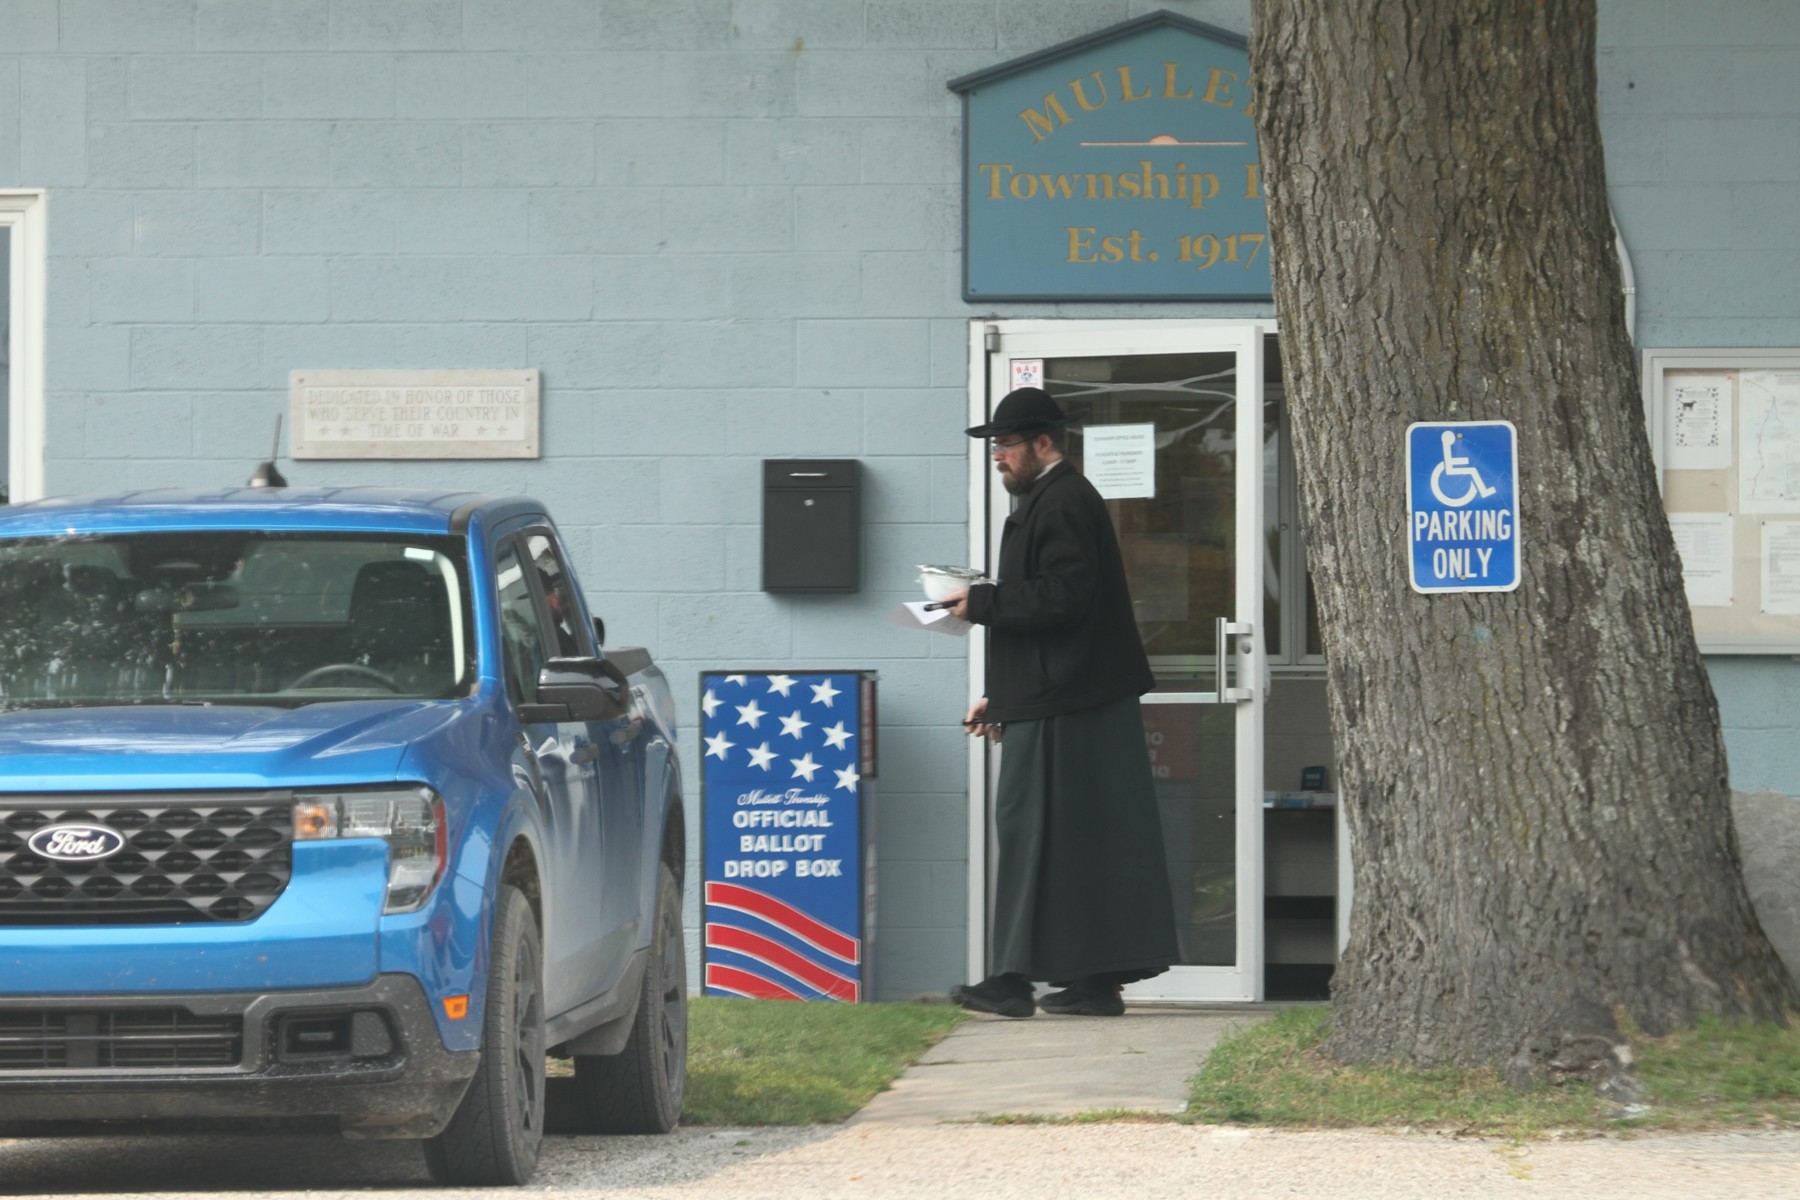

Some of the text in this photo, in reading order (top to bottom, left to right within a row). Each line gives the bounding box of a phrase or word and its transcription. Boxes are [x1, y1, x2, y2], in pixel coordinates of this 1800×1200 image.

[1017, 61, 1255, 144] MULLE
[978, 160, 1220, 208] Township
[1065, 226, 1266, 271] Est. 1917
[306, 389, 521, 405] DEDICATED IN HONOR OF THOSE
[308, 406, 340, 421] WHO
[392, 406, 431, 421] THEIR
[436, 406, 498, 421] COUNTRY
[504, 406, 520, 420] IN
[368, 423, 459, 438] TIME OF WAR
[1415, 509, 1511, 541] PARKING
[1433, 548, 1493, 579] ONLY
[732, 810, 834, 828] OFFICIAL
[46, 830, 105, 854] Ford
[740, 834, 827, 853] BALLOT
[724, 859, 843, 878] DROP BOX
